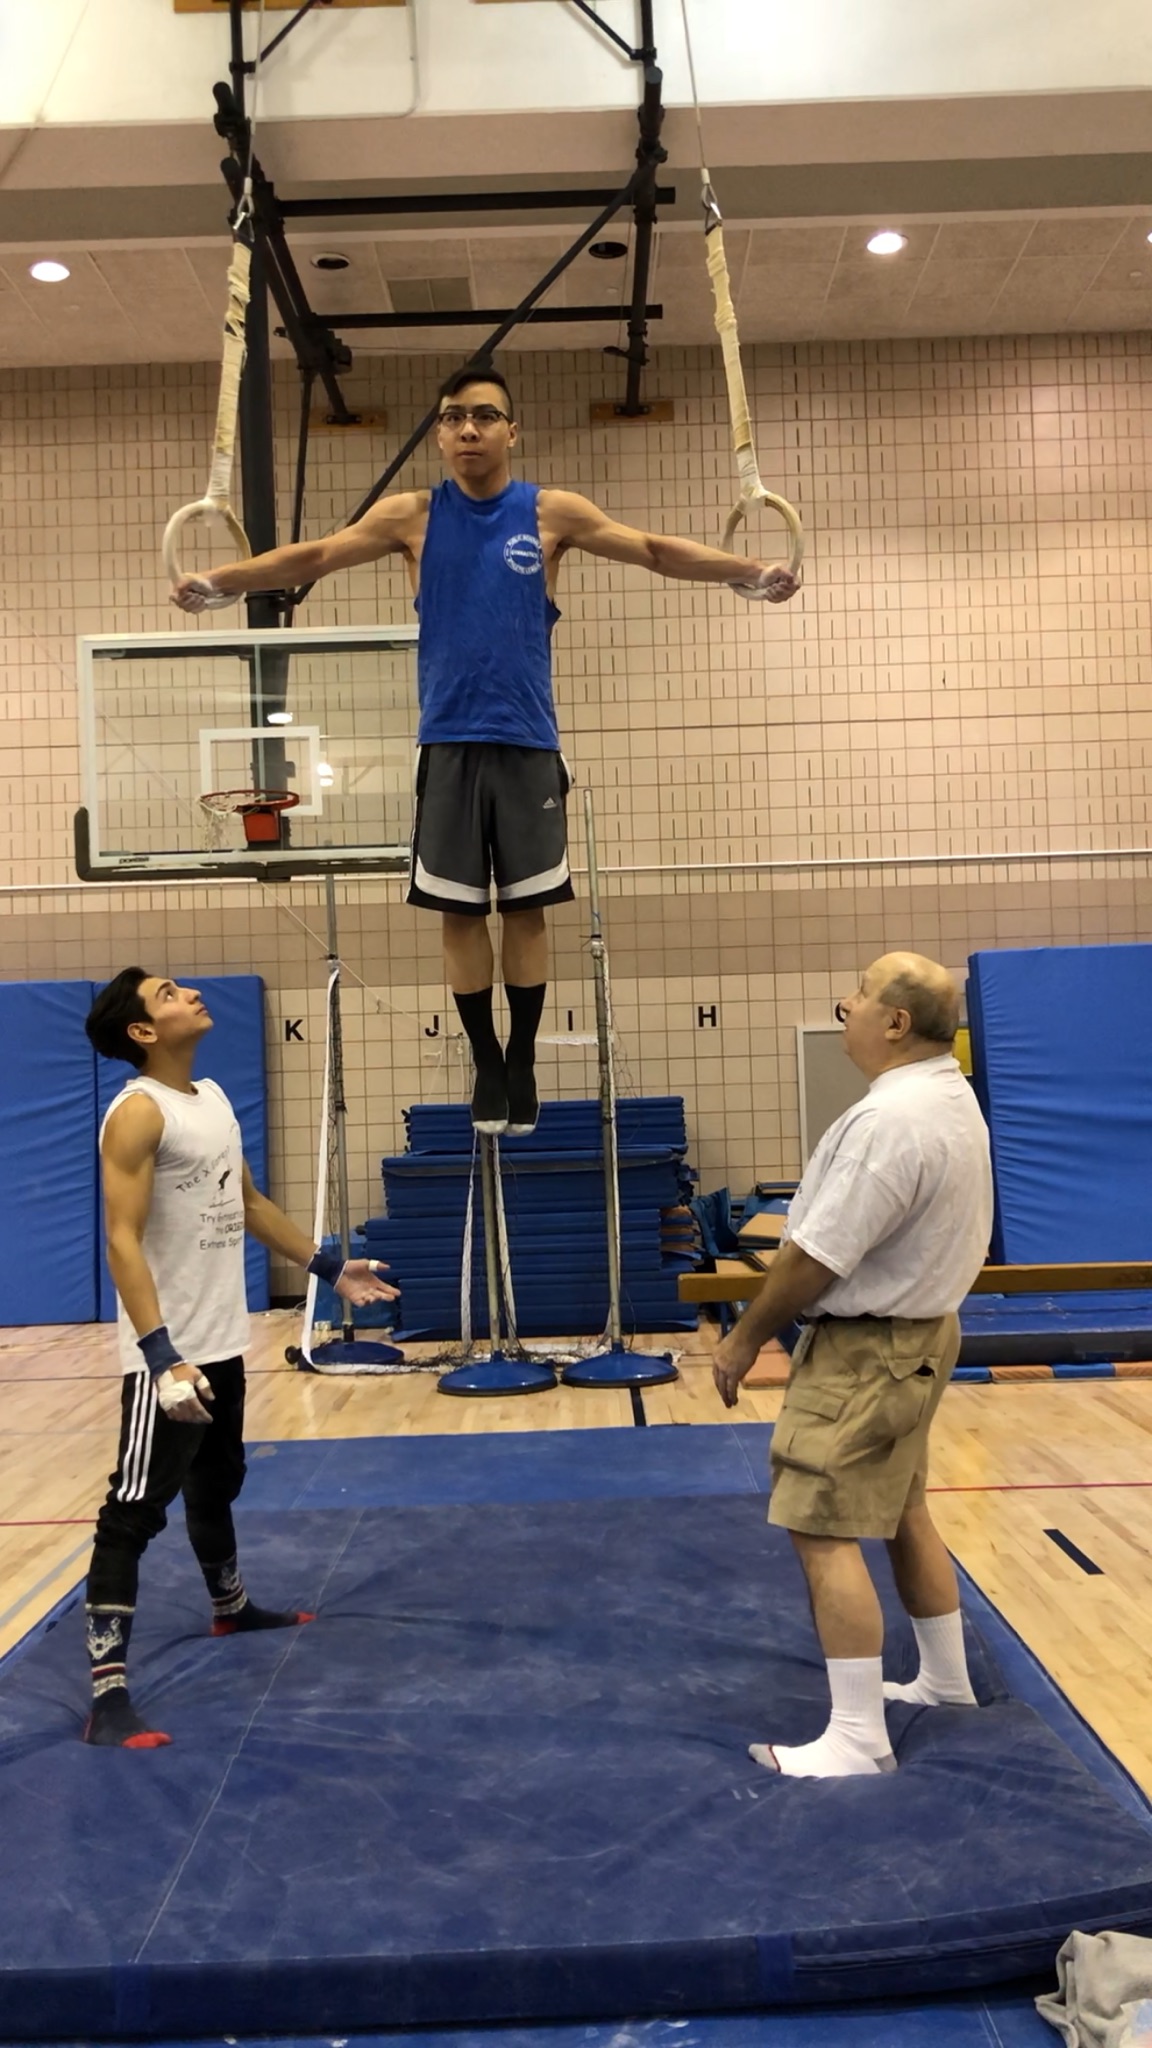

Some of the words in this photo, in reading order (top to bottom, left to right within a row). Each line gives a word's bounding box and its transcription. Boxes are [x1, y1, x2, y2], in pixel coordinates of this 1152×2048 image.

[425, 1015, 439, 1037] J
[567, 1010, 573, 1031] I
[698, 1005, 716, 1027] H
[285, 1019, 304, 1041] K
[175, 1176, 200, 1192] The
[200, 1213, 215, 1224] Try
